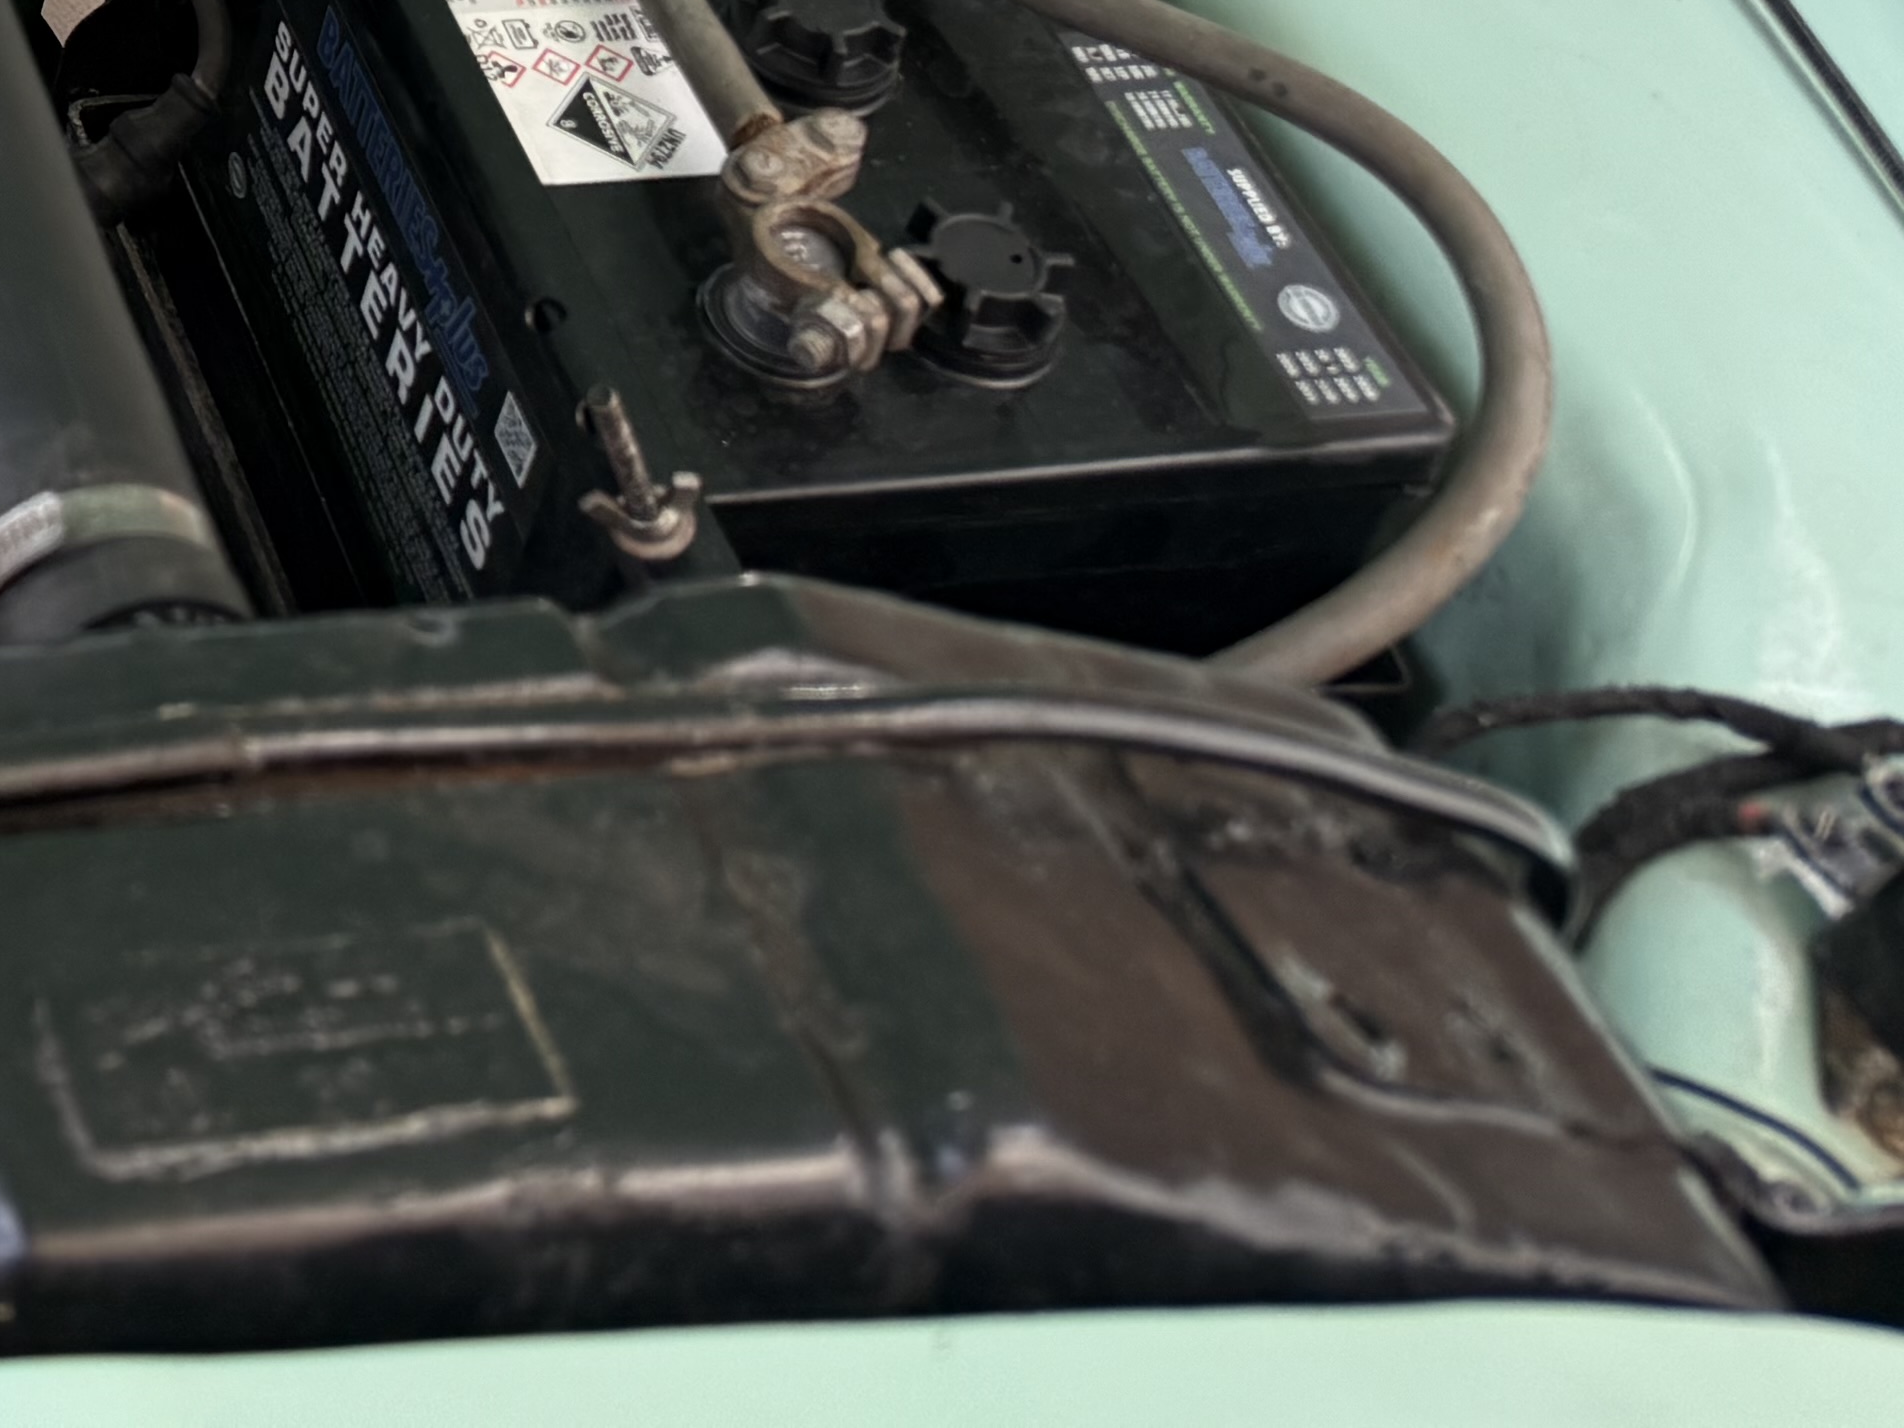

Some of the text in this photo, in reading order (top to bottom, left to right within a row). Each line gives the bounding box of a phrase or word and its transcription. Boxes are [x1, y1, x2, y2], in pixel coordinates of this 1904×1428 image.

[582, 91, 626, 155] CORROSIVE
[647, 128, 688, 170] UN2794
[1227, 167, 1277, 225] SUPPLIED
[275, 21, 505, 522] SUPER HEAVY DUTY
[264, 50, 492, 572] BATTERIES
